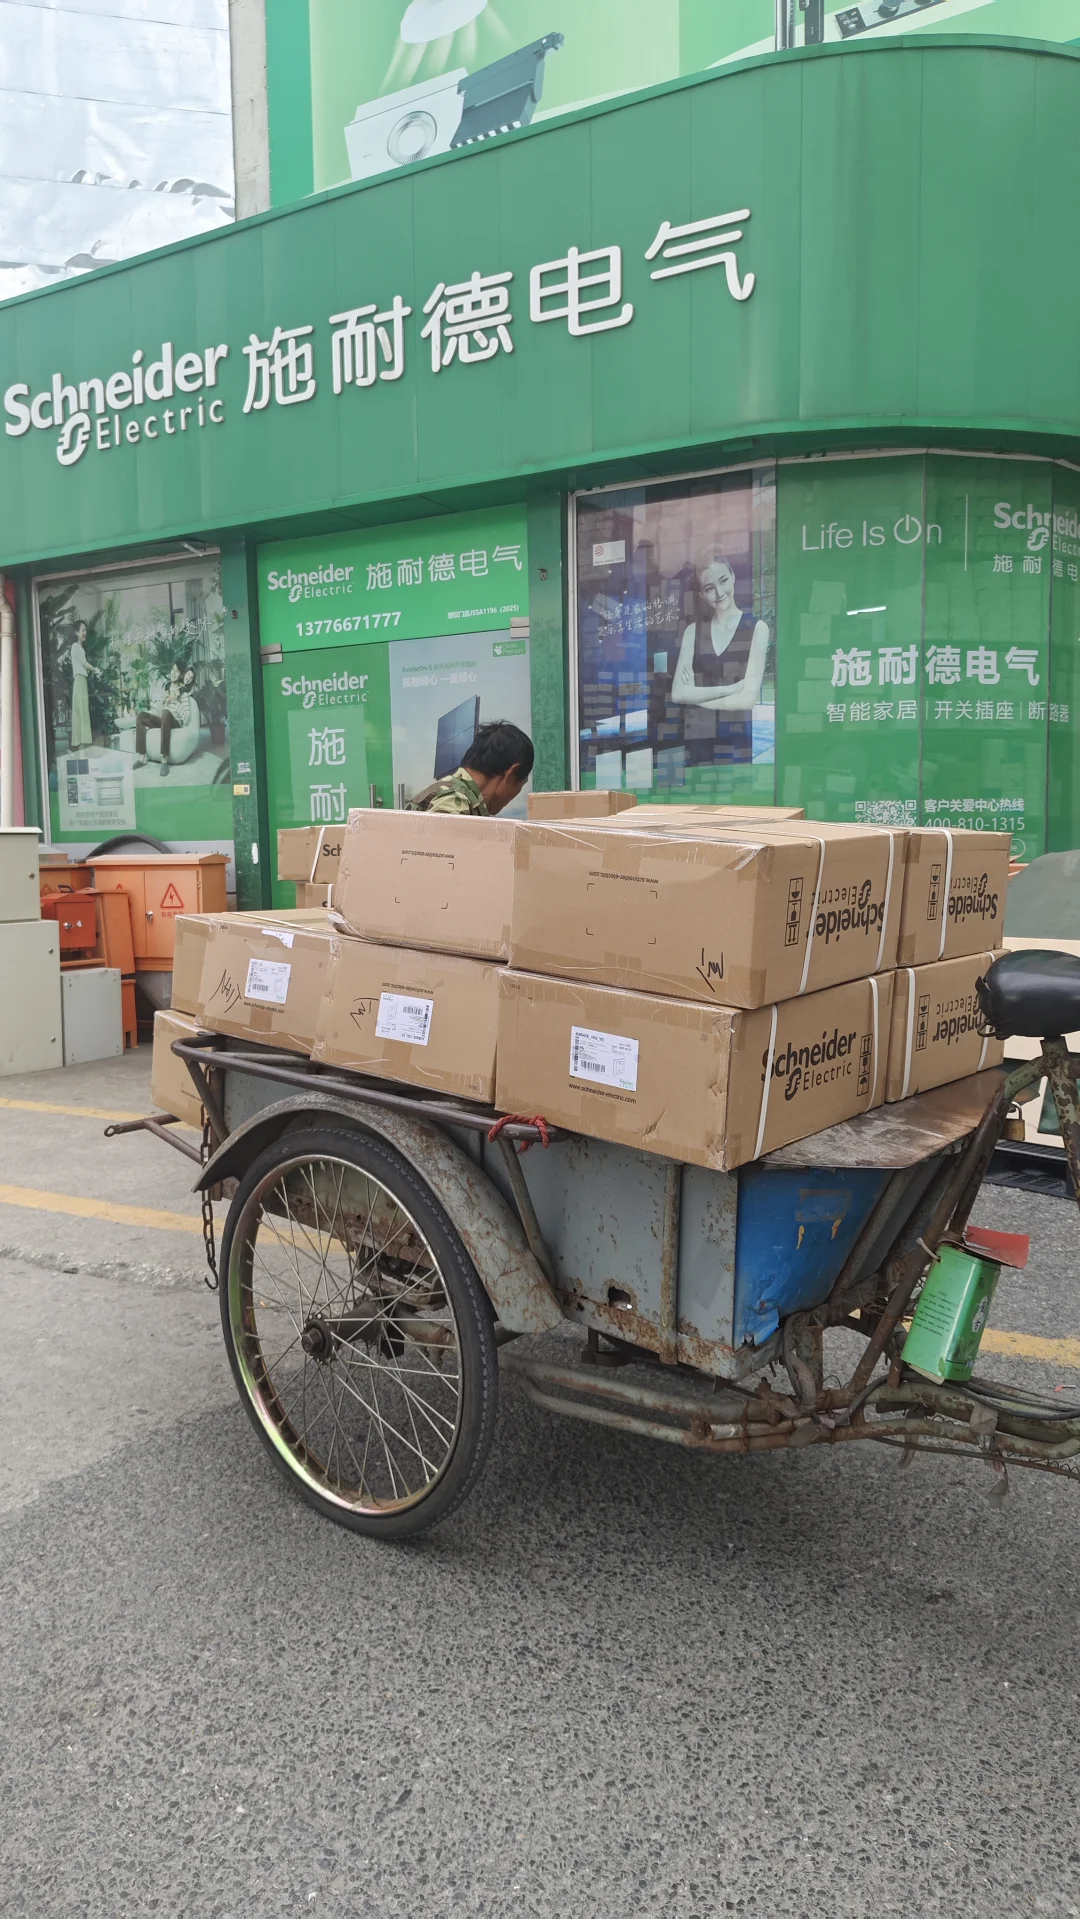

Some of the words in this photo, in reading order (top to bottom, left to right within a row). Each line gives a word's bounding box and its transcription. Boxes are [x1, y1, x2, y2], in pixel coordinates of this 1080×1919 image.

[242, 208, 756, 414] 施耐德电气
[4, 342, 229, 437] Schneider
[95, 397, 225, 451] Electric
[801, 524, 853, 551] Life
[862, 520, 885, 547] Is
[892, 514, 942, 545] On
[267, 563, 354, 591] Schneider
[366, 544, 523, 591] 施耐德电气
[304, 583, 353, 599] Electric
[296, 611, 402, 637] 13776671777
[830, 644, 1041, 688] 施耐德电气
[281, 671, 369, 697] Schneider
[318, 693, 368, 707] Electric
[826, 700, 919, 723] 智能家居
[934, 700, 1015, 721] 开关插座
[1028, 701, 1070, 723] 断路器
[924, 799, 1025, 813] 客户关爱中心热线
[924, 817, 1026, 831] 400-810-1315
[588, 870, 660, 885] www.schneider-electric.com
[935, 995, 973, 1018] Electric
[802, 1059, 853, 1092] Electric
[568, 1082, 637, 1105] www.schneider-electric.com
